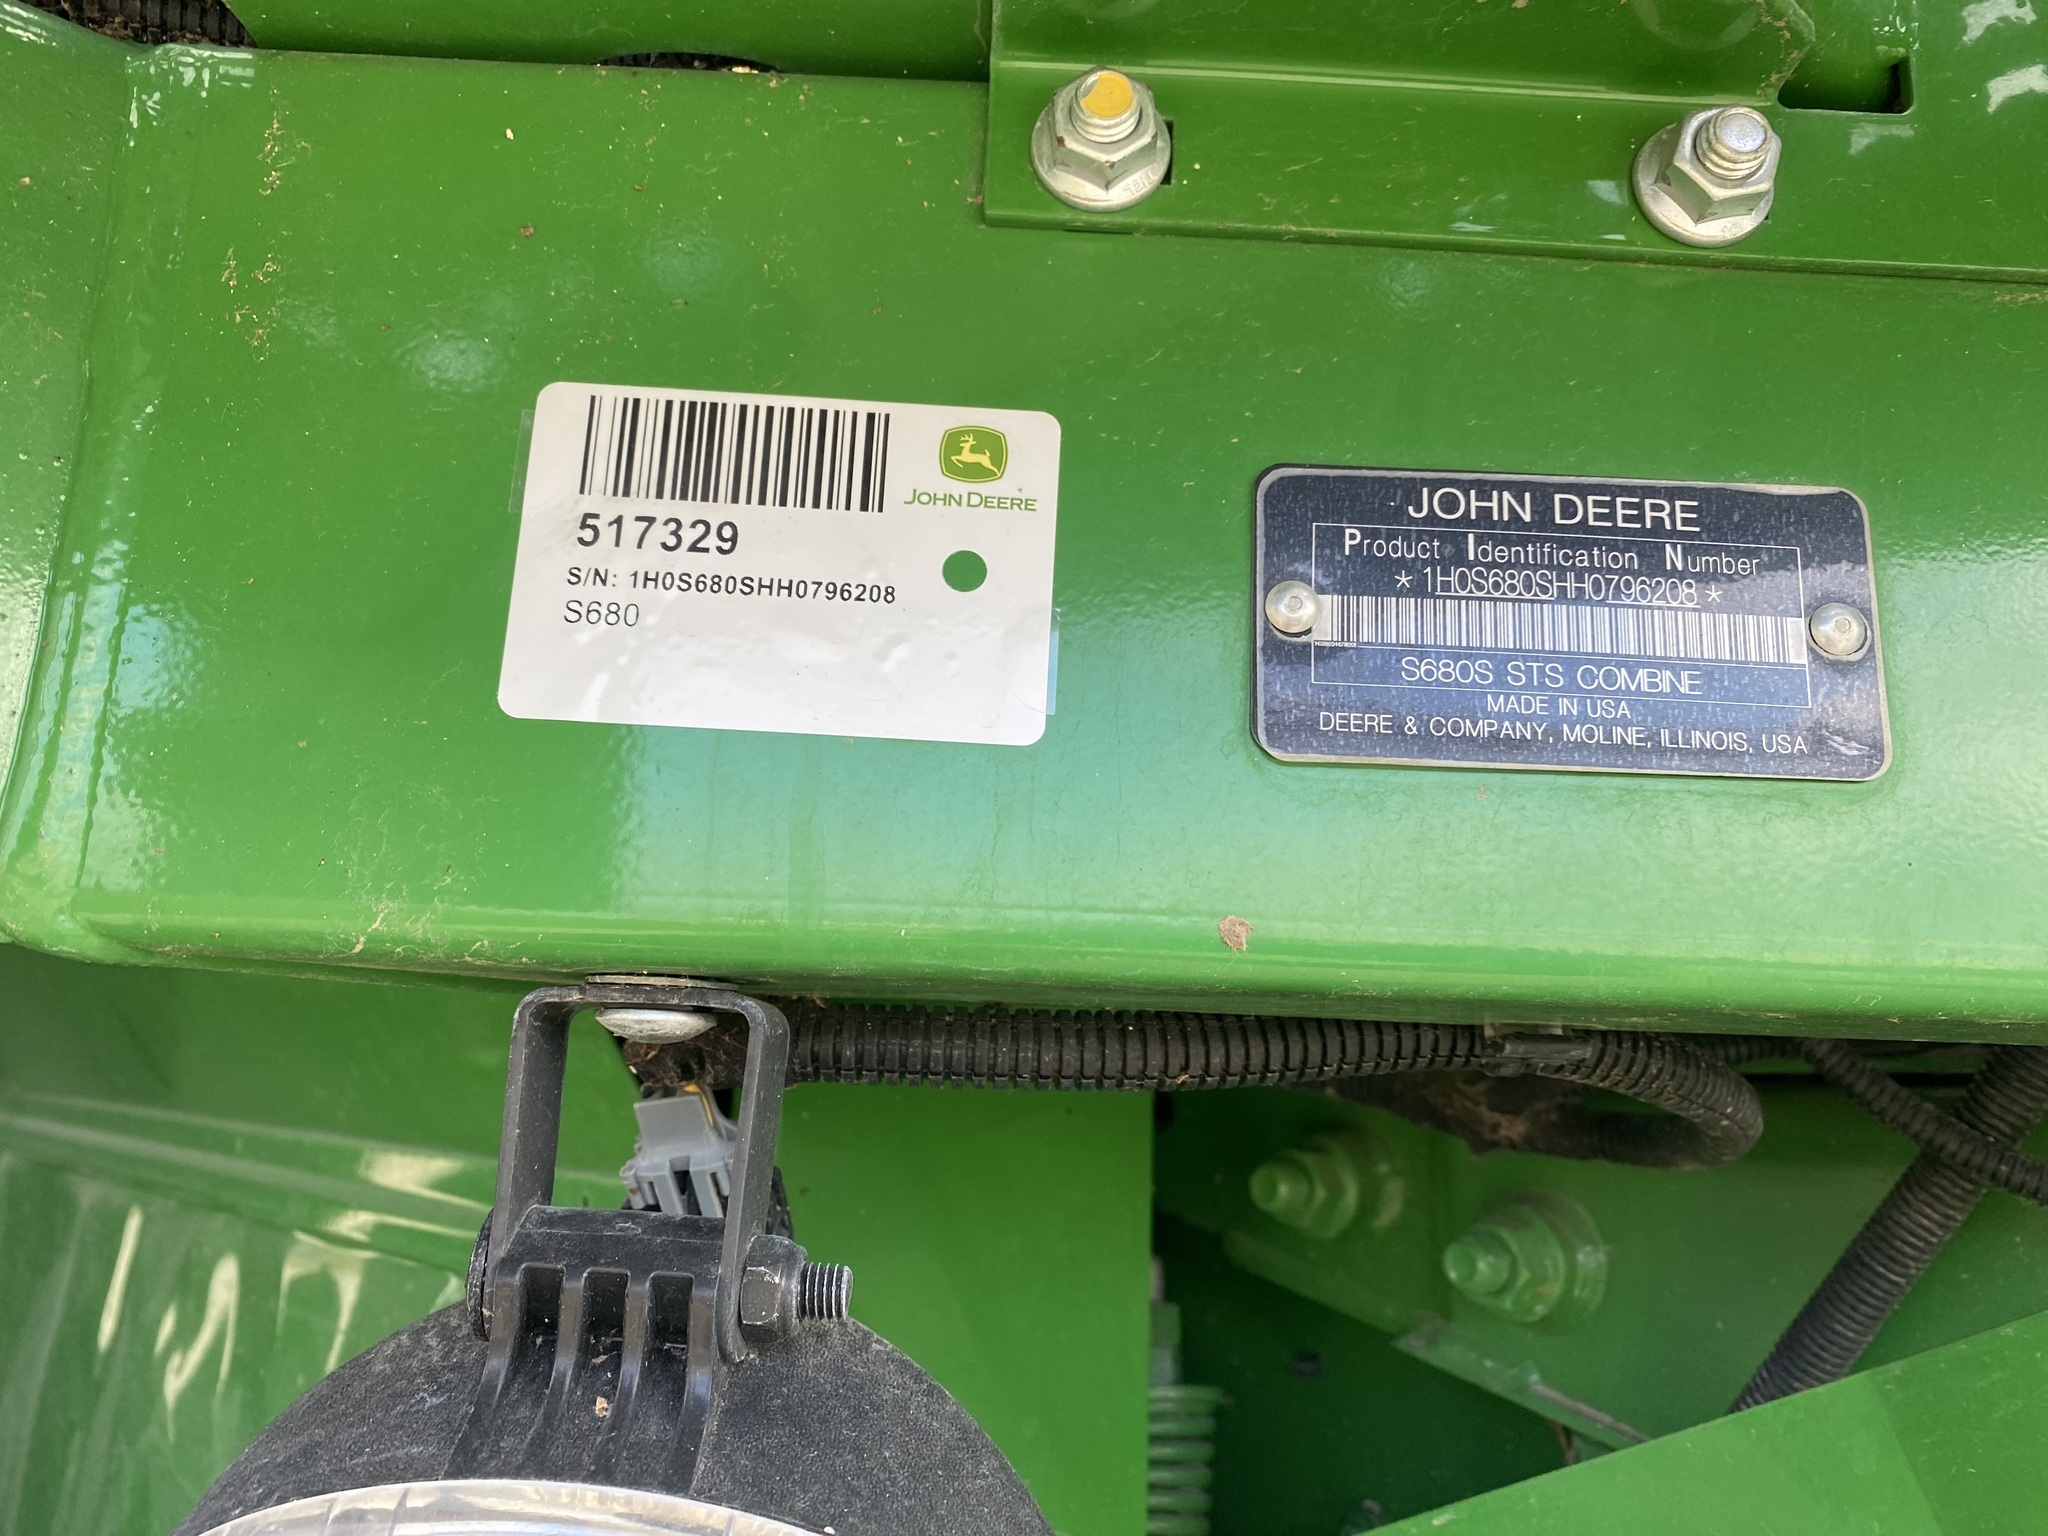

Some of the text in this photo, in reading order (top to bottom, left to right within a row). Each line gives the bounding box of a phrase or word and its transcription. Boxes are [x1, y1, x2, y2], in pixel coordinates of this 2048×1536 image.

[903, 489, 1037, 512] JOHN DEERE
[1408, 487, 1700, 532] JOHN DEERE
[577, 513, 738, 555] 517329
[1344, 528, 1760, 575] Product Identification Number
[567, 567, 896, 604] S/N: 1H0S680SHH0796208
[564, 599, 640, 626] S680
[1401, 656, 1703, 695] S680S STS COMBINE
[1487, 694, 1632, 719] MADE IN USA
[1319, 711, 1808, 755] DEERE & COMPANY, MOLINE, ILLINOIS, USA
